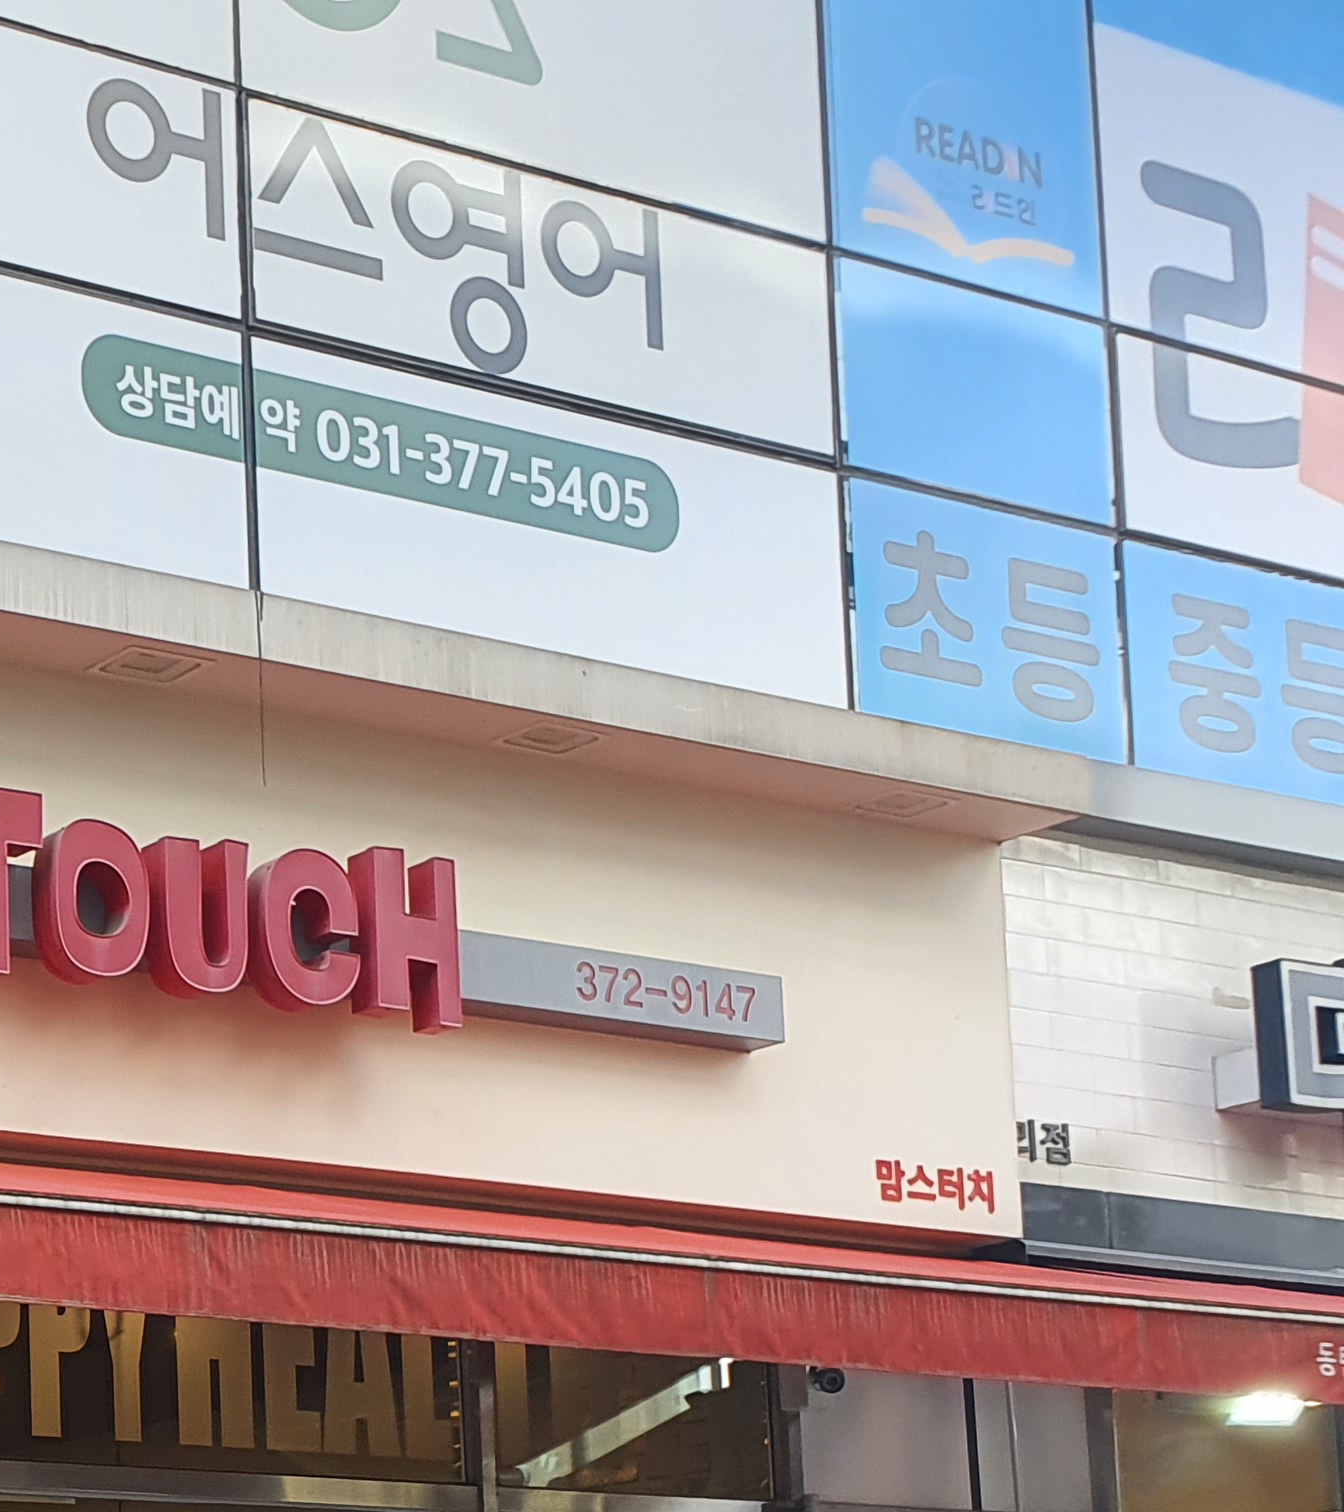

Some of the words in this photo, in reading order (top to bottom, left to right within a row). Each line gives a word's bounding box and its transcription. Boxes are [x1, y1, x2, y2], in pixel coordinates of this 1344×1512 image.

[315, 410, 650, 529] 031-377-5405
[878, 530, 1101, 723] 초등
[575, 961, 758, 1024] 372-9147
[874, 1158, 996, 1214] 맘스터치
